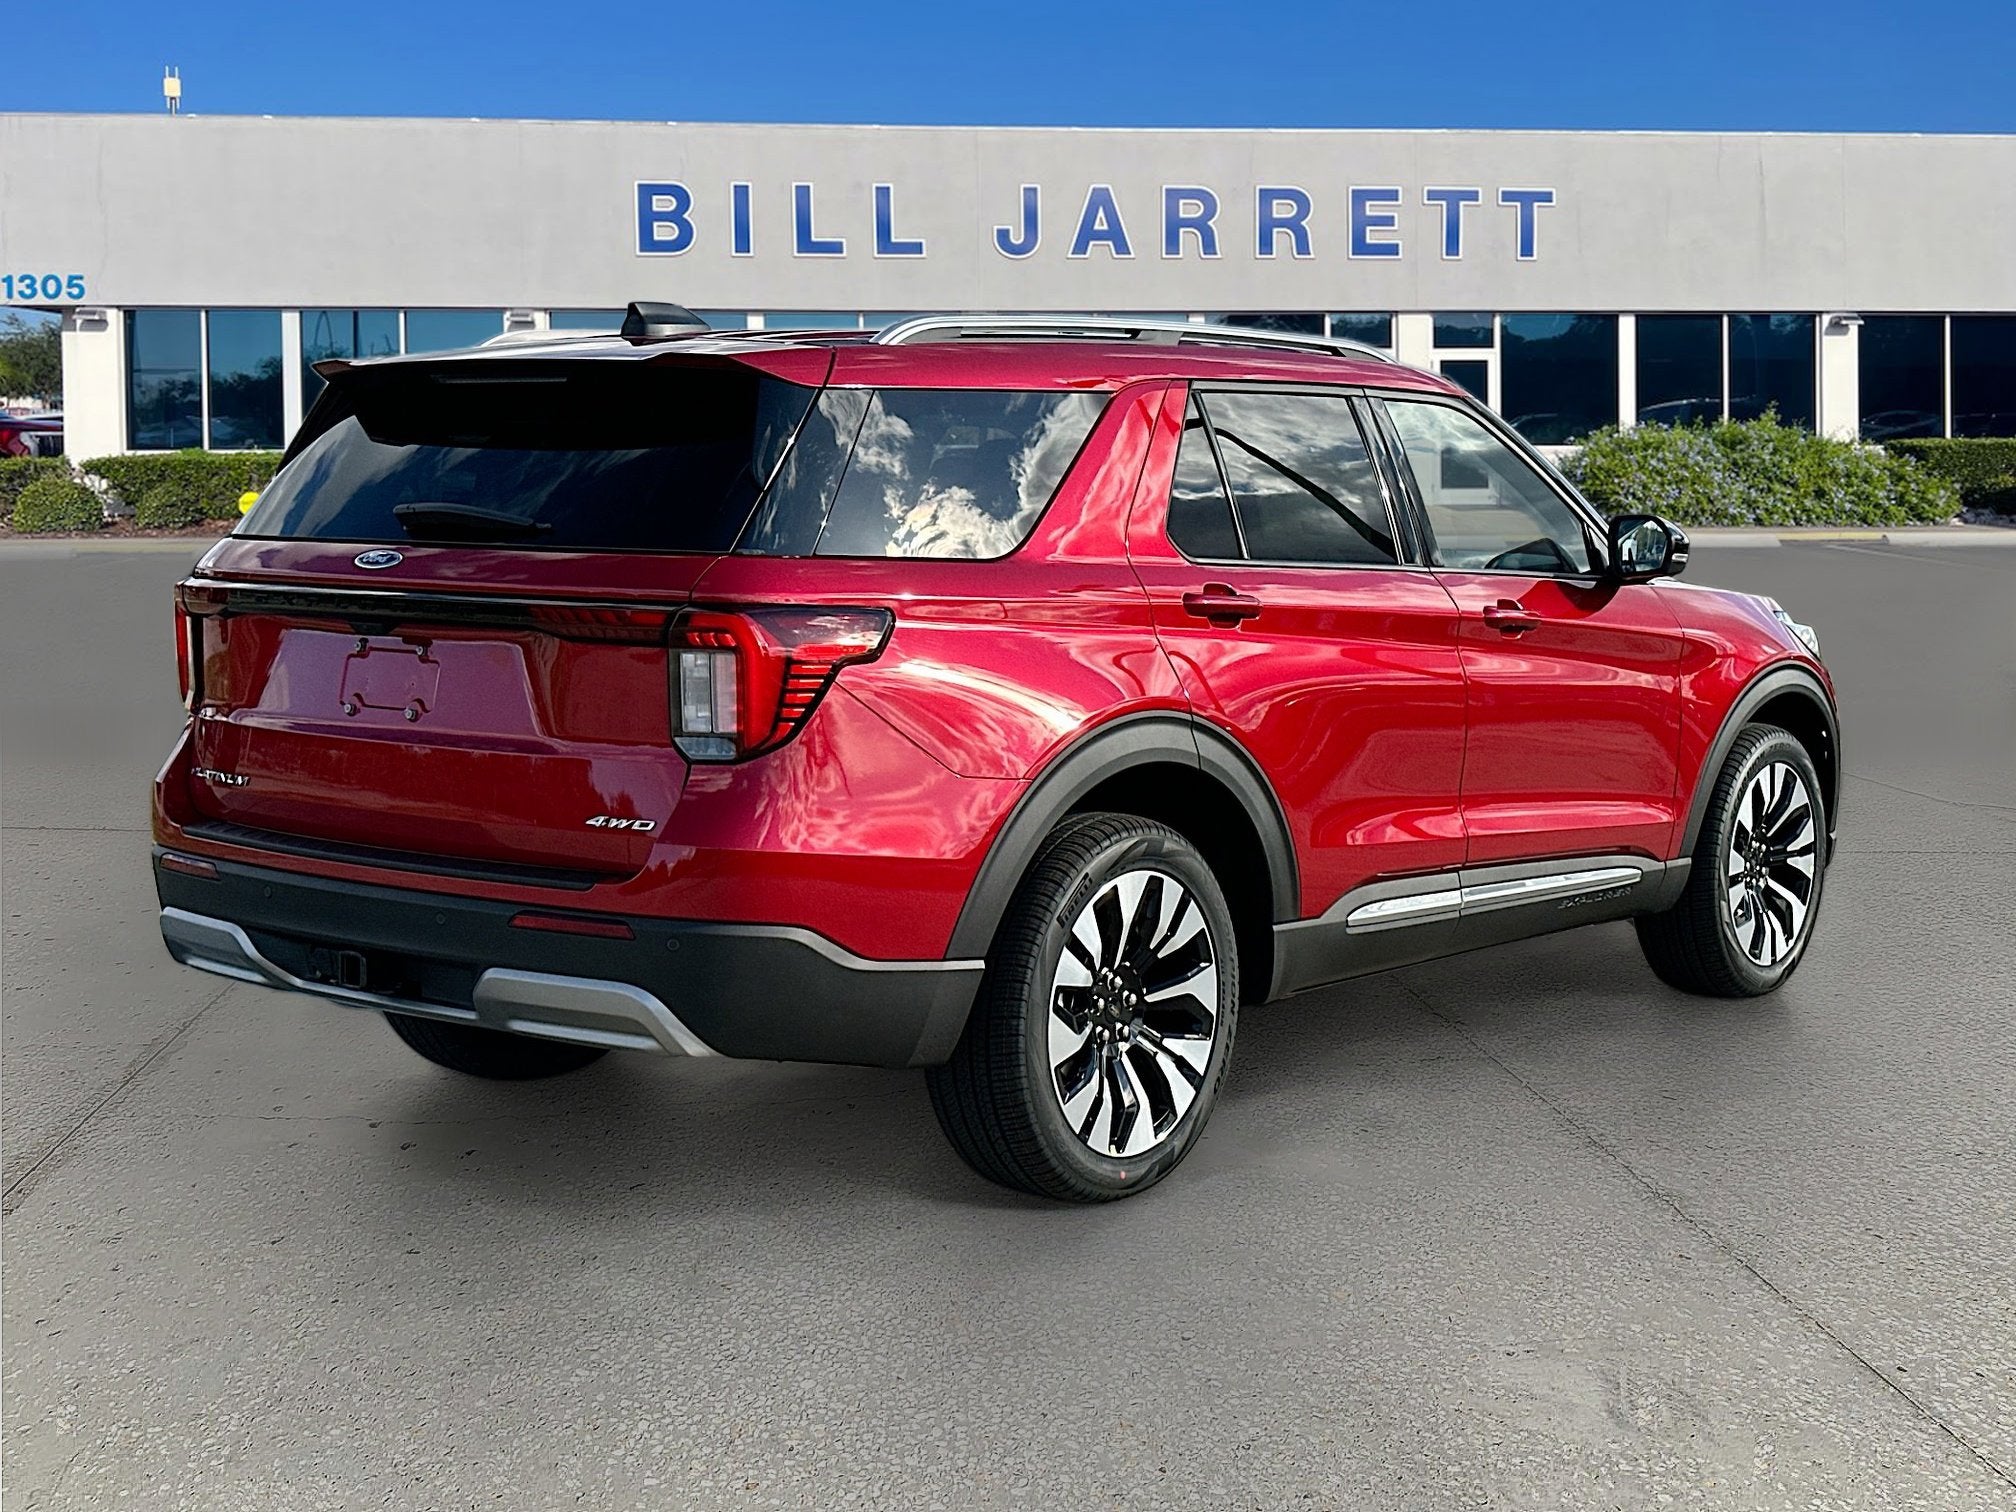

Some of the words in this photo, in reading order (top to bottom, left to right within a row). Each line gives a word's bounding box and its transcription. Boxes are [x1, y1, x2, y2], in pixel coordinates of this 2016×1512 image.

[635, 180, 925, 260] BILL
[993, 183, 1556, 262] JARRETT
[1, 274, 86, 300] 1305
[585, 815, 656, 831] 4WD
